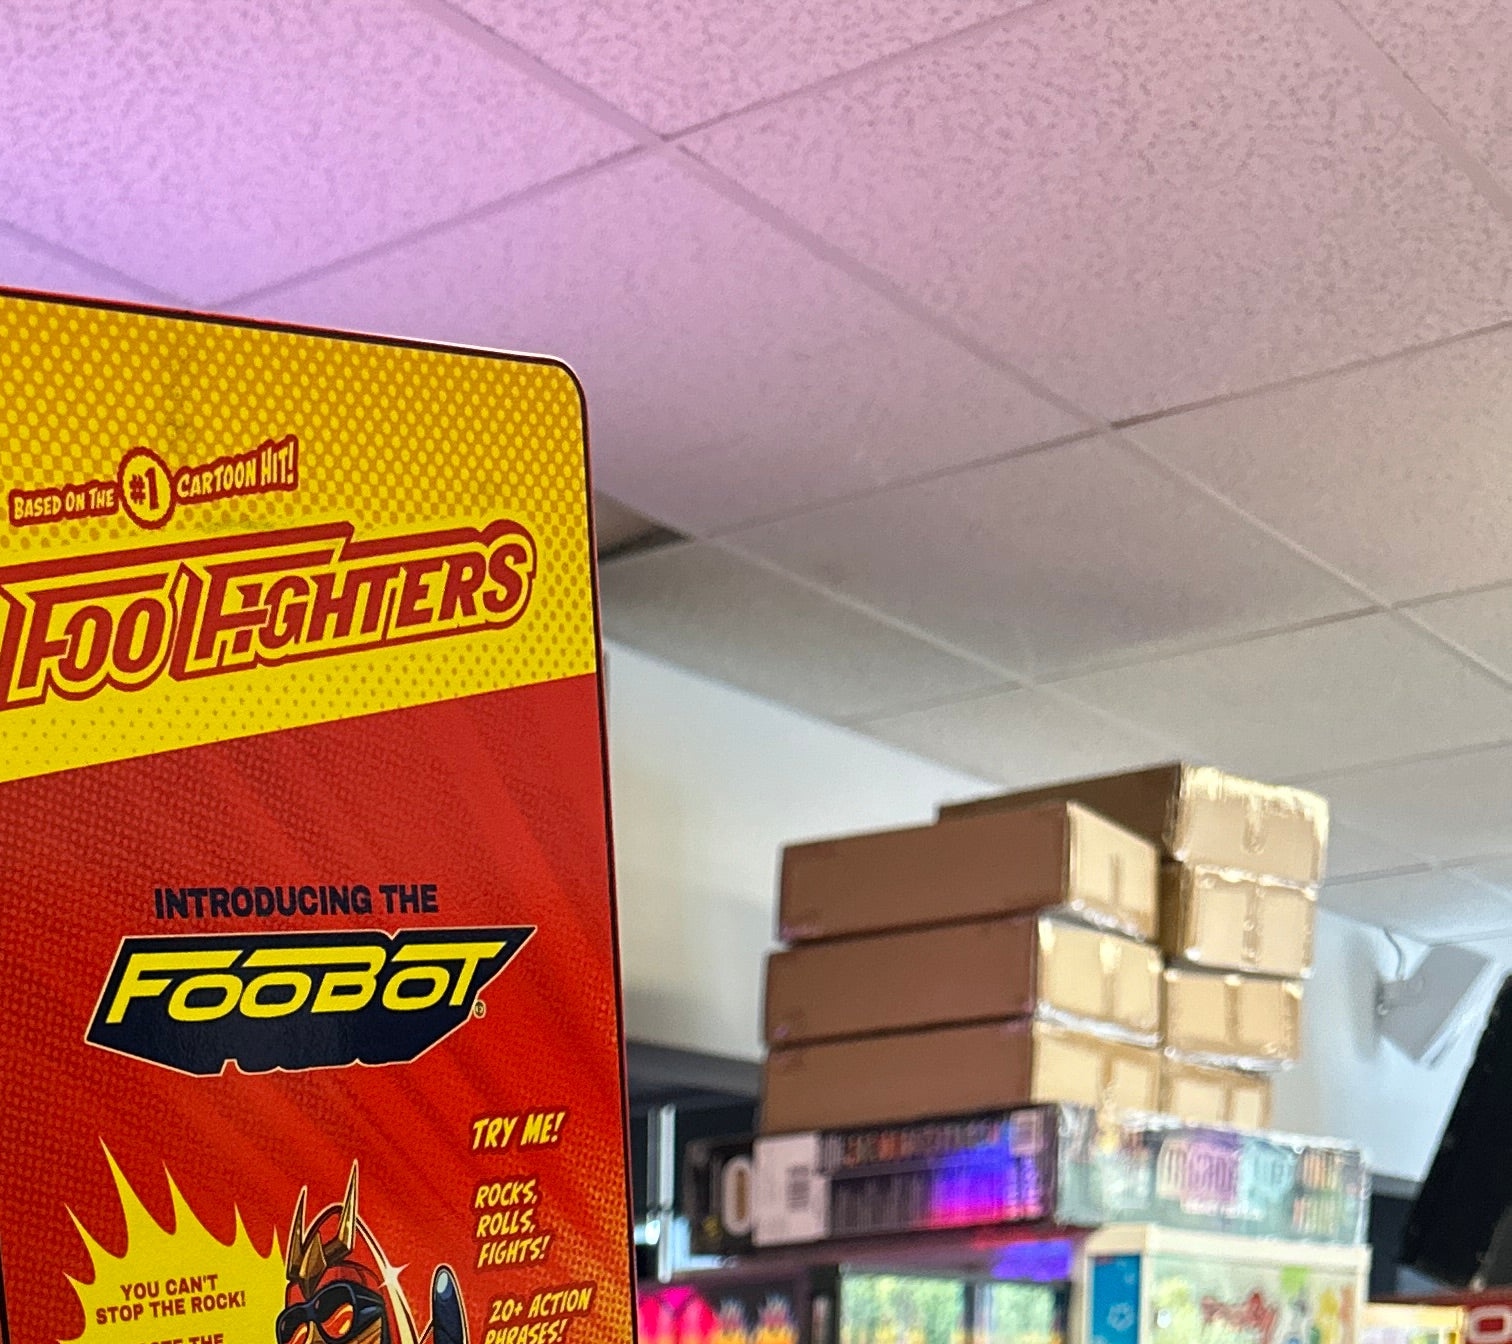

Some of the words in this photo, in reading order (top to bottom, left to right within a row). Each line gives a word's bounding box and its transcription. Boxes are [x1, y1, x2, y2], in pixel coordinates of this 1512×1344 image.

[13, 495, 61, 520] BASED
[65, 490, 85, 512] ON
[89, 486, 115, 509] THE
[129, 466, 159, 511] #1
[177, 457, 257, 498] CARTOON
[260, 441, 295, 487] HIT!
[178, 533, 535, 668] FIGHTERS
[154, 884, 372, 920] INTRODUCING
[379, 882, 439, 915] THE
[104, 941, 506, 1025] FOOBOT
[472, 1115, 518, 1151] TRY
[520, 1111, 565, 1146] ME!
[475, 1179, 538, 1209] ROCKS,
[476, 1208, 535, 1238] ROLLS,
[477, 1235, 551, 1269] FIGHTS!
[120, 1280, 159, 1301] YOU
[166, 1273, 218, 1296] CAN'T
[489, 1299, 524, 1324] 20+
[528, 1287, 593, 1319] ACTION
[96, 1303, 144, 1325] STOP
[149, 1298, 186, 1318] THE
[191, 1290, 246, 1314] ROCK!
